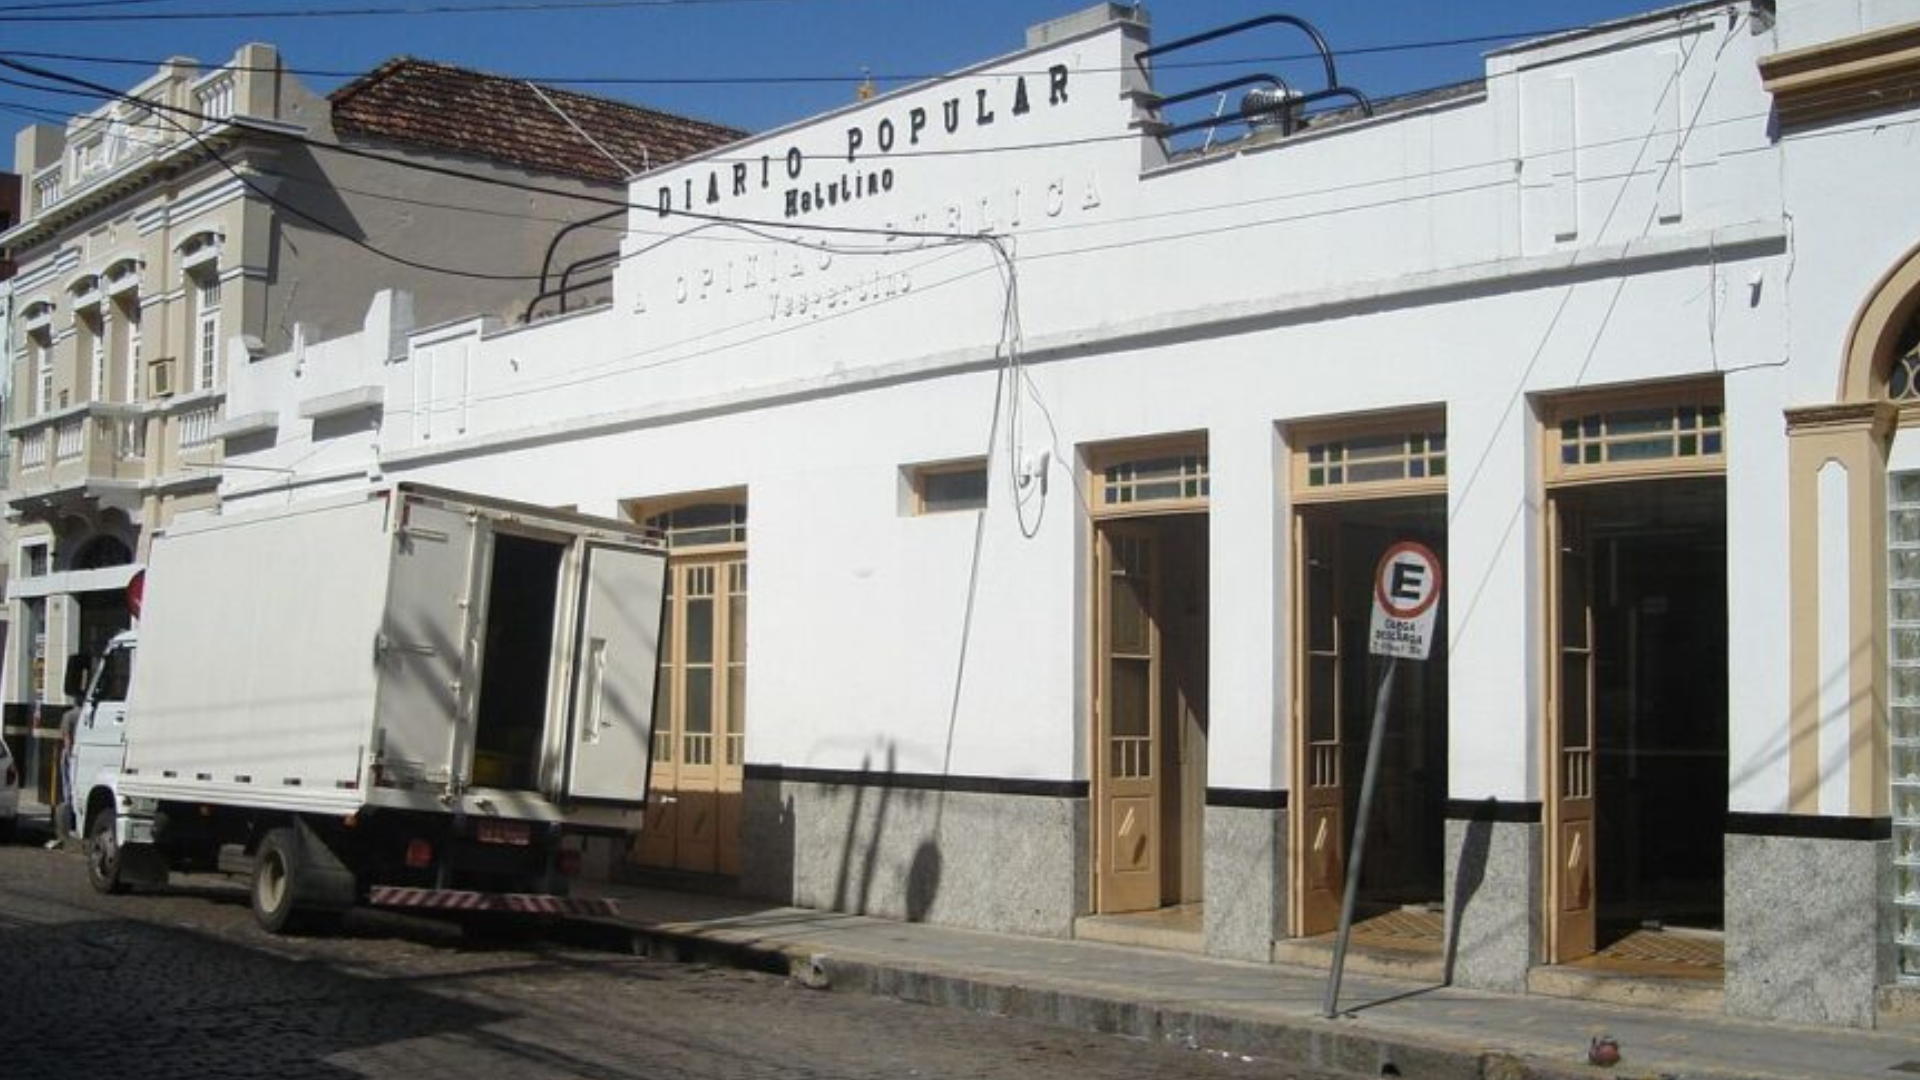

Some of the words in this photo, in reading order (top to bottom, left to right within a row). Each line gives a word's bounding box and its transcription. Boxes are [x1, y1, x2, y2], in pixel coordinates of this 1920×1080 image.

[658, 146, 802, 218] DIARIO
[847, 64, 1069, 162] POPULAR
[785, 168, 894, 218] Matutino
[1391, 562, 1424, 600] E
